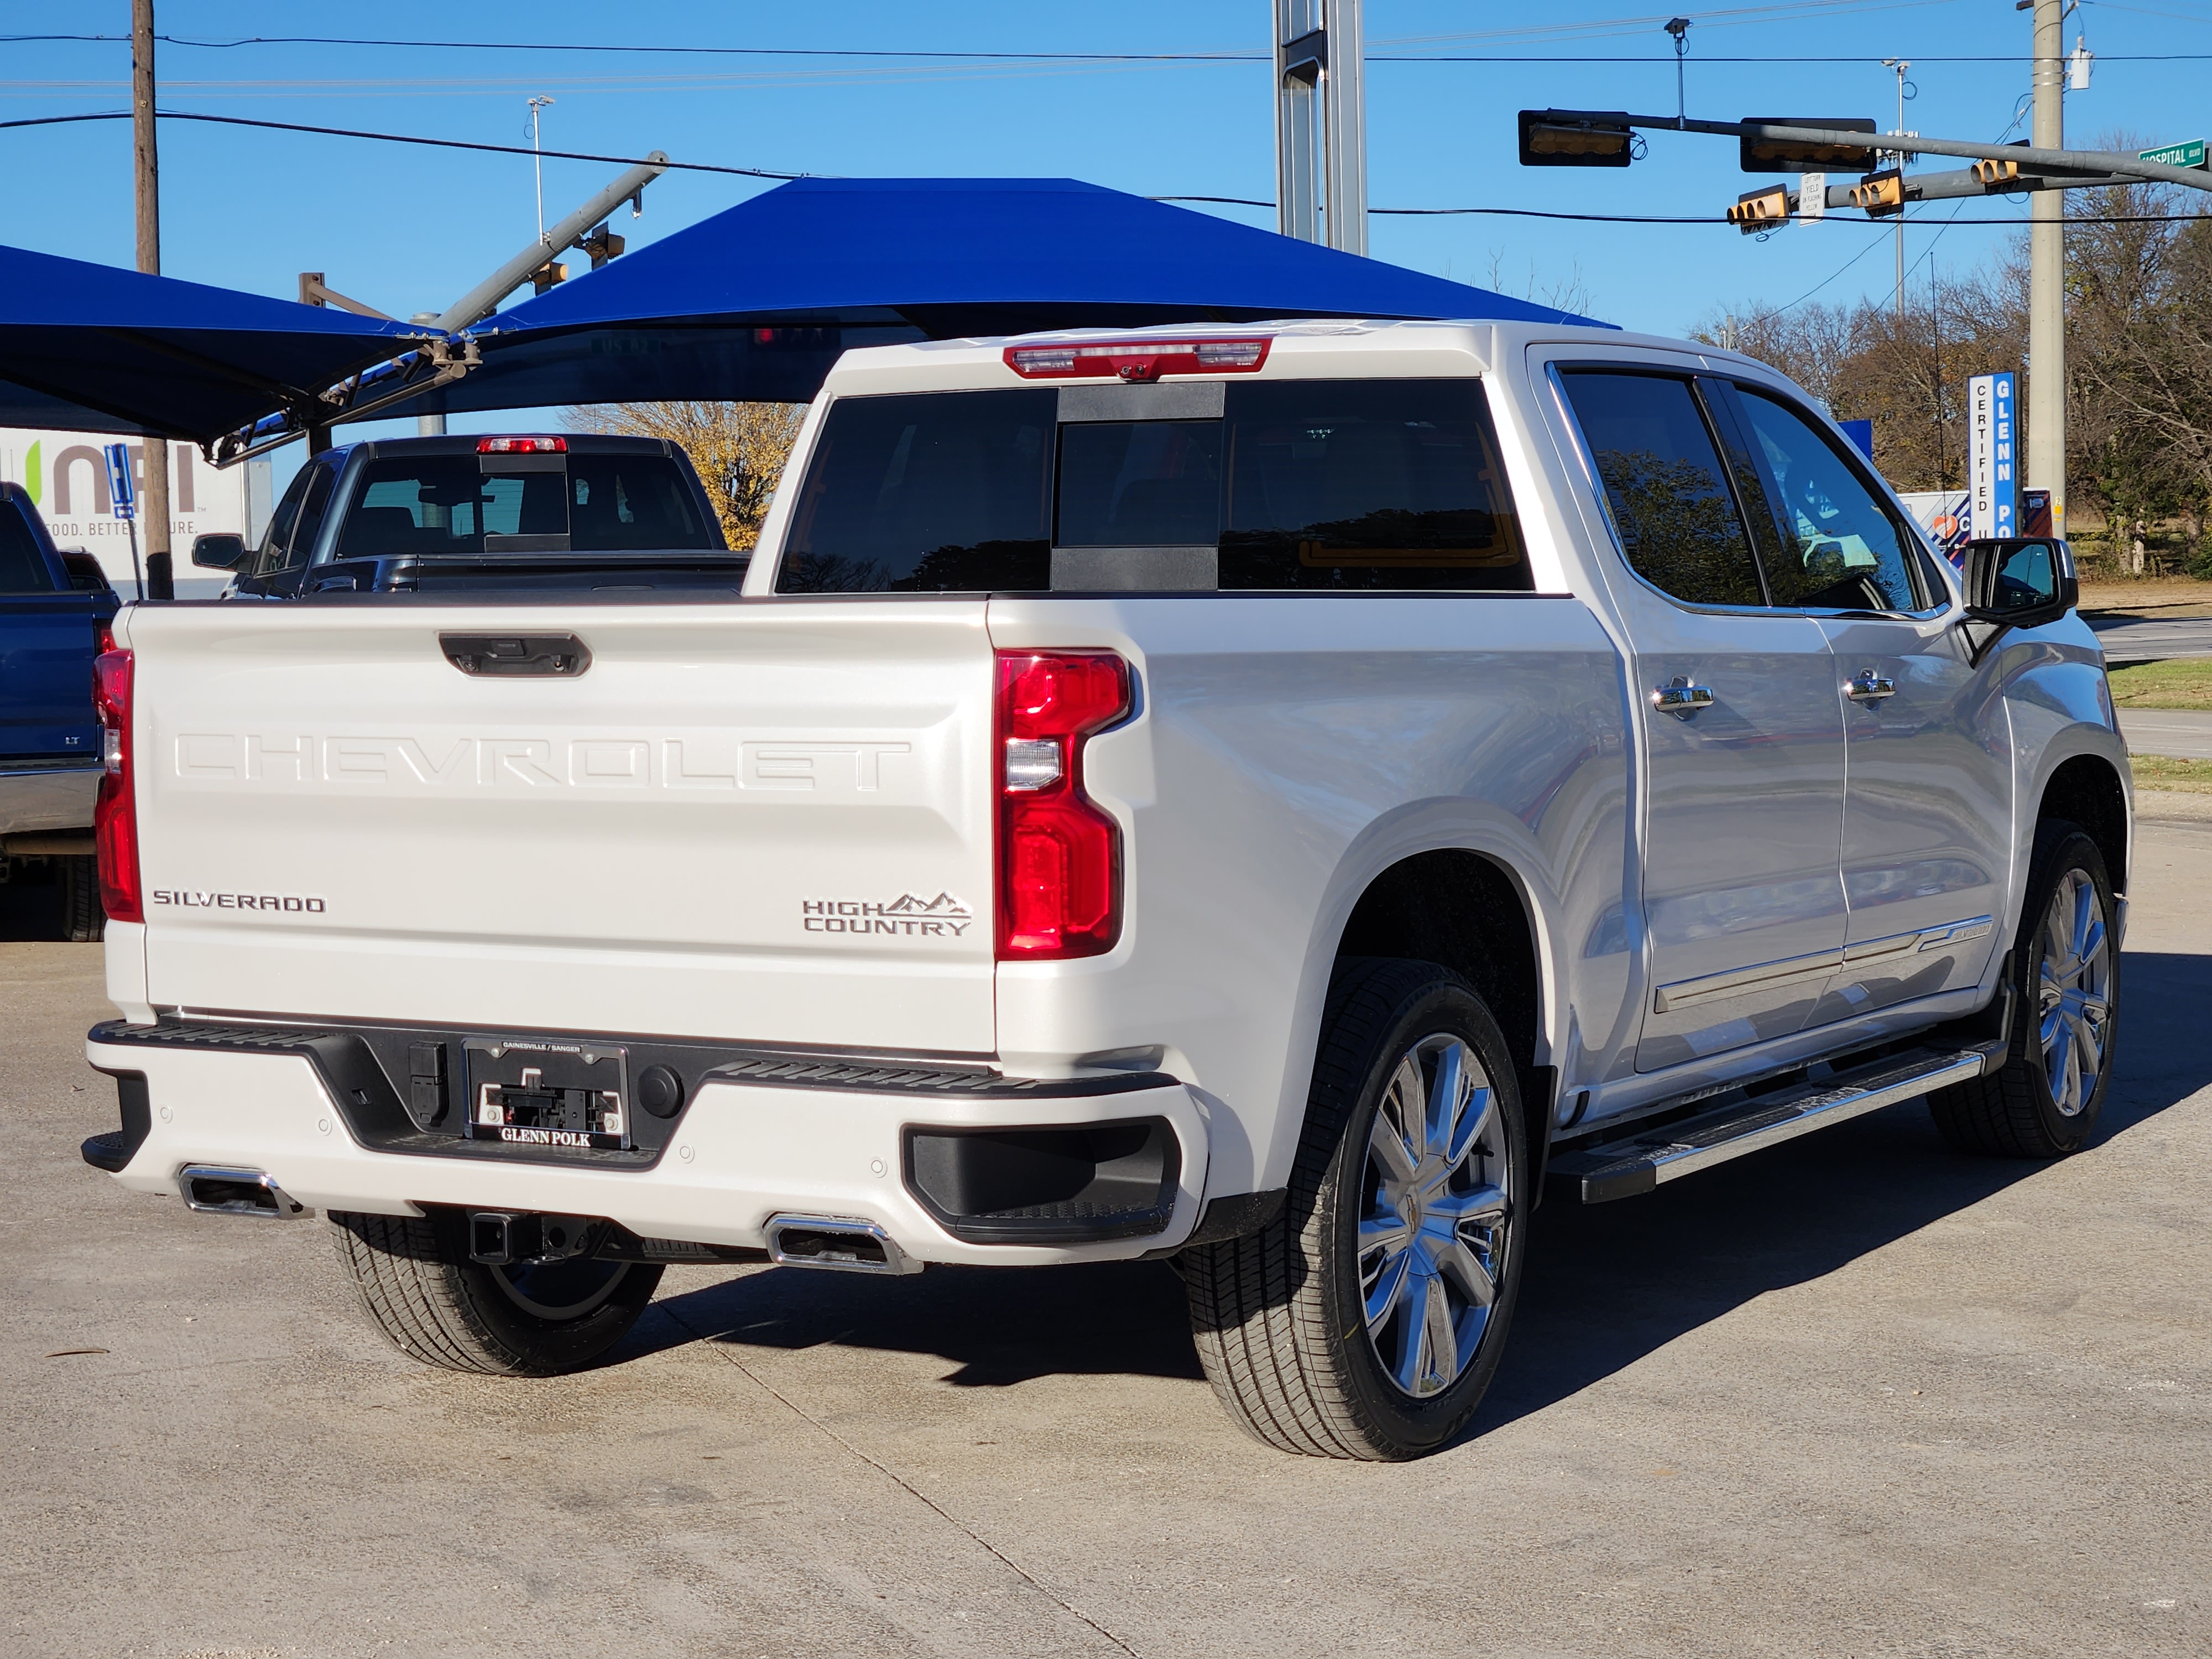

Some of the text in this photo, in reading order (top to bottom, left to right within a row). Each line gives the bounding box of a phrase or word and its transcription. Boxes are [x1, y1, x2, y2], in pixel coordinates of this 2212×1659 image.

[1806, 184, 1819, 194] YIELD
[1997, 380, 2010, 481] GLENN
[1978, 385, 1987, 512] CERTIFIED
[2056, 497, 2061, 506] 2
[65, 737, 80, 745] LT
[175, 734, 911, 791] CHEVROLET
[154, 890, 326, 912] SILVERADO
[803, 900, 885, 916] HIGH
[805, 917, 971, 936] COUNTRY
[502, 1128, 591, 1147] GLENN POLK
